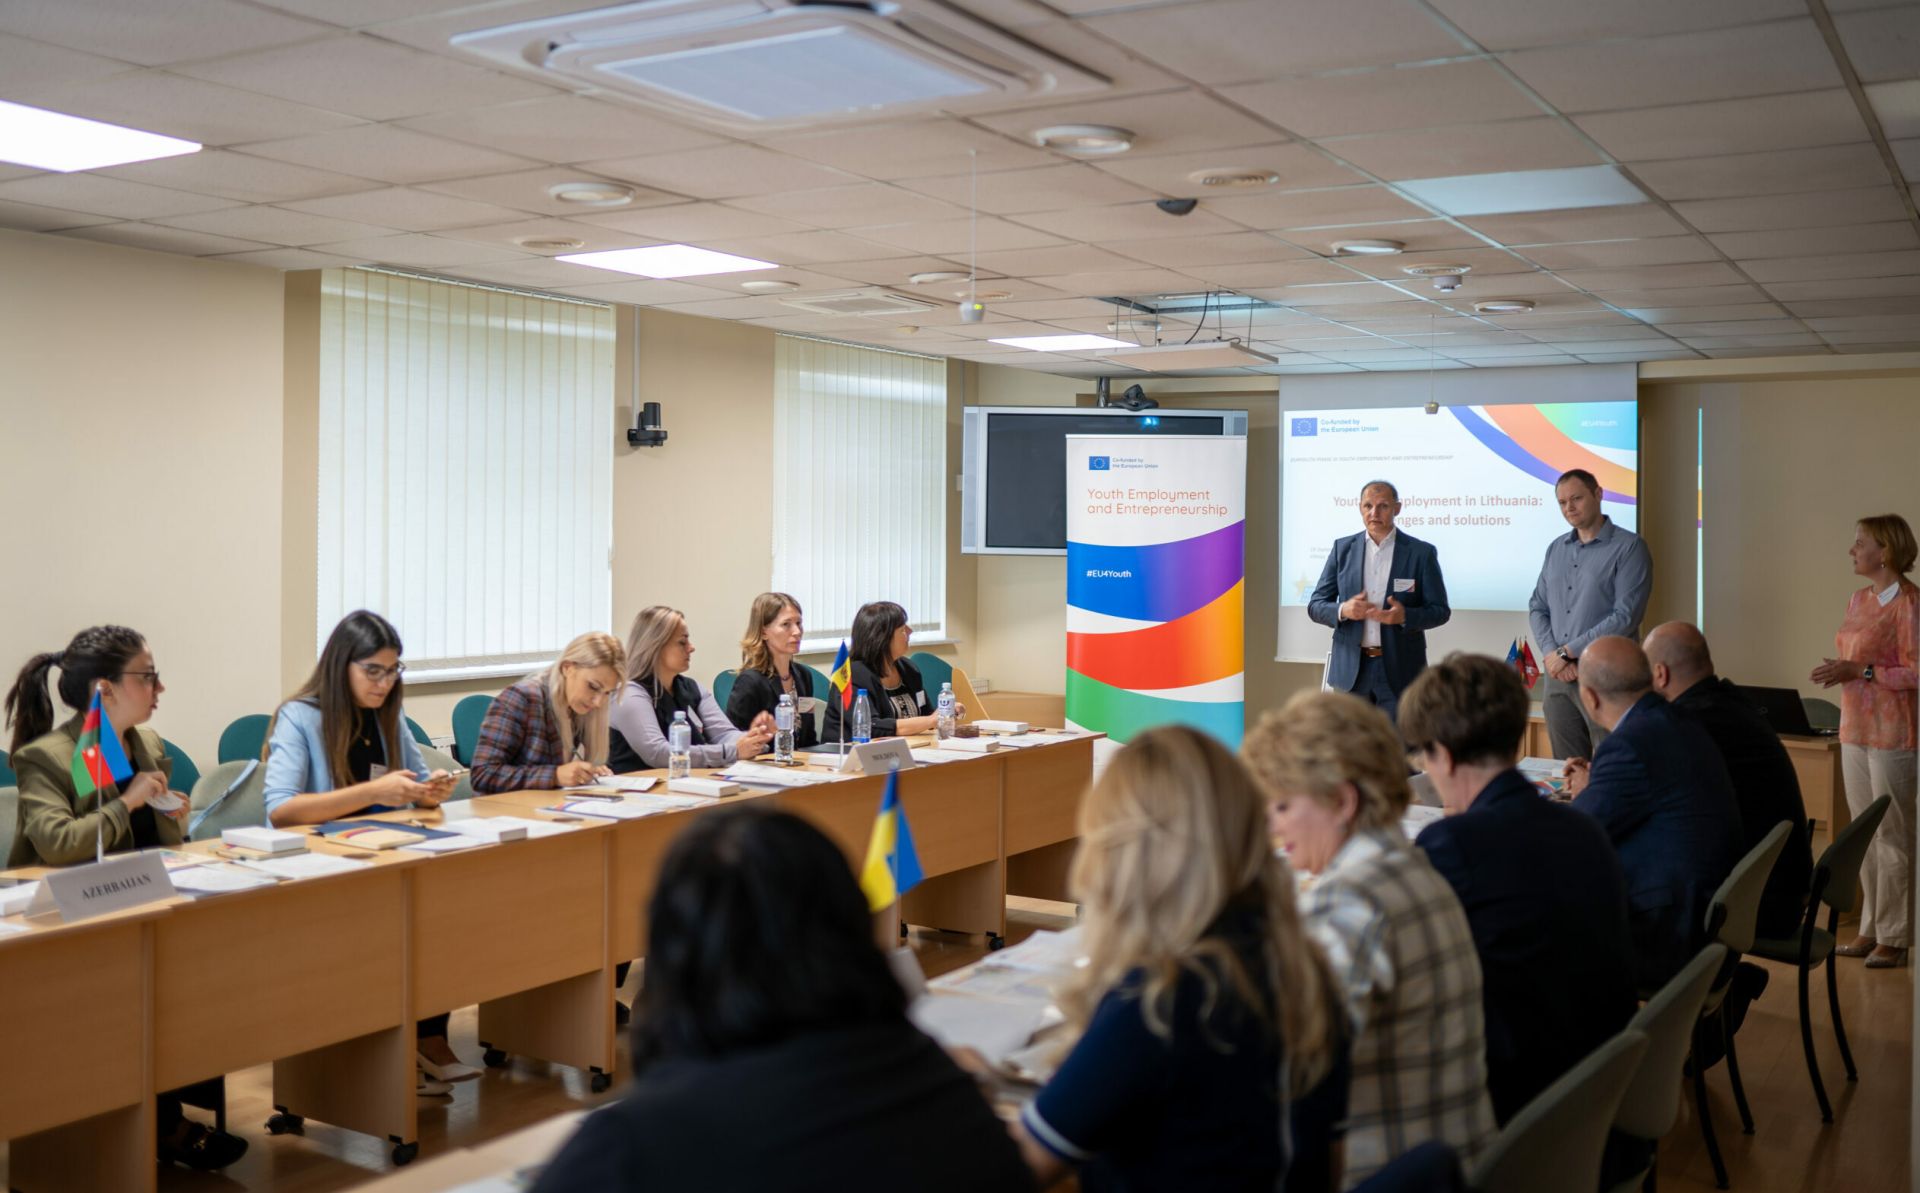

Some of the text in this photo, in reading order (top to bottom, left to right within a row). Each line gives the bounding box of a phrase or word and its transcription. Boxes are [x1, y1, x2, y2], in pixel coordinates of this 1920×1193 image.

[1353, 418, 1360, 426] by
[1087, 489, 1211, 502] Youth Employment
[1333, 495, 1543, 508] Yout ployment in Lithuania:
[1087, 503, 1228, 517] and Entrepreneurship
[1428, 514, 1451, 526] and
[1454, 514, 1511, 526] solutions
[1086, 569, 1132, 578] #EU4Youth
[81, 873, 152, 901] AZERBAIJAN
